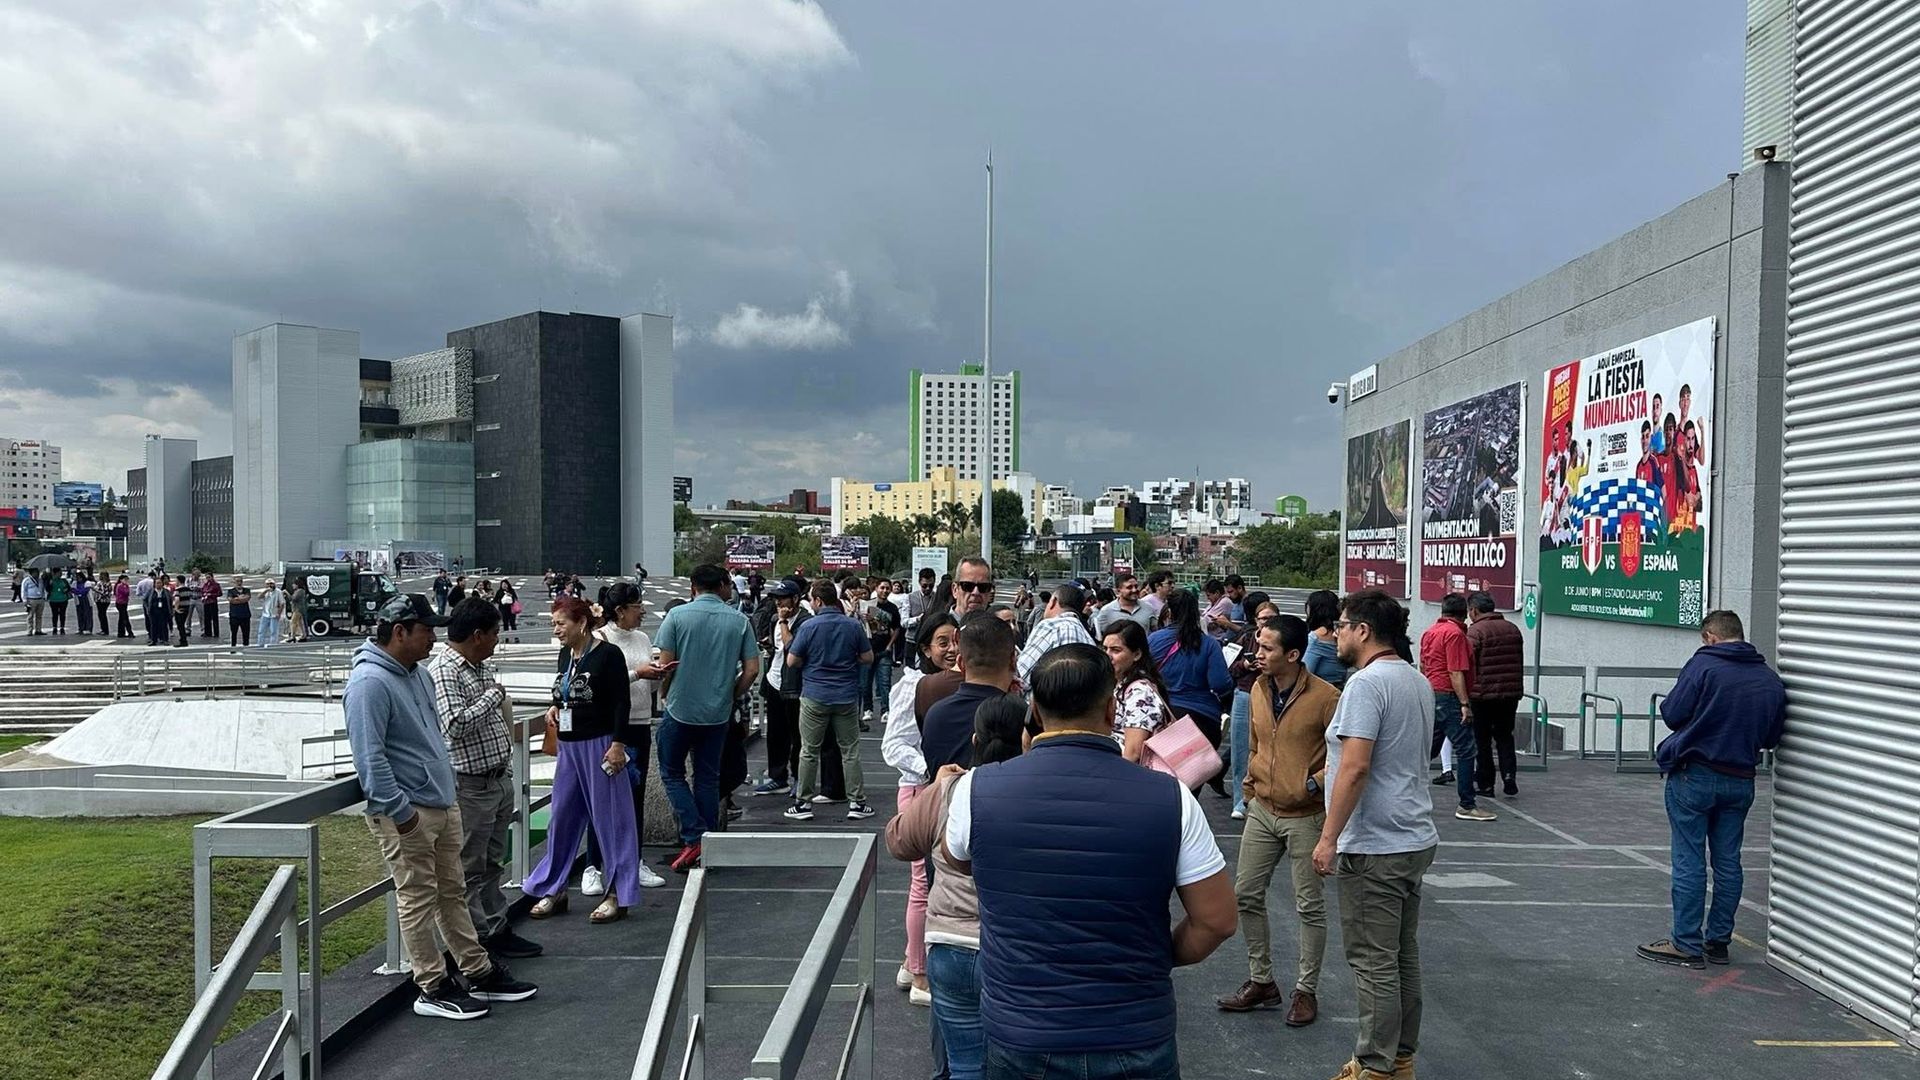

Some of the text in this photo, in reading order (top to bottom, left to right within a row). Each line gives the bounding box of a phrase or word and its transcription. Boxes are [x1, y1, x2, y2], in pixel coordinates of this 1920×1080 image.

[1597, 348, 1635, 370] AQUÍ EMPIEZA
[1588, 373, 1602, 402] LA
[1605, 360, 1645, 398] FIESTA
[1583, 390, 1648, 431] MUNDIALISTA
[1424, 514, 1480, 538] PAVIMENTACIÓN
[1366, 546, 1376, 560] SAN
[1376, 545, 1396, 560] CARLOS
[1423, 542, 1506, 568] BULEVAR ATLIXCO
[1561, 551, 1679, 571] PERÚ VS ESPAÑA
[1568, 587, 1575, 596] DE
[1575, 587, 1589, 597] JUNIO
[1605, 588, 1626, 599] ESTADIO
[1626, 588, 1663, 601] CUAUHTÉMOC
